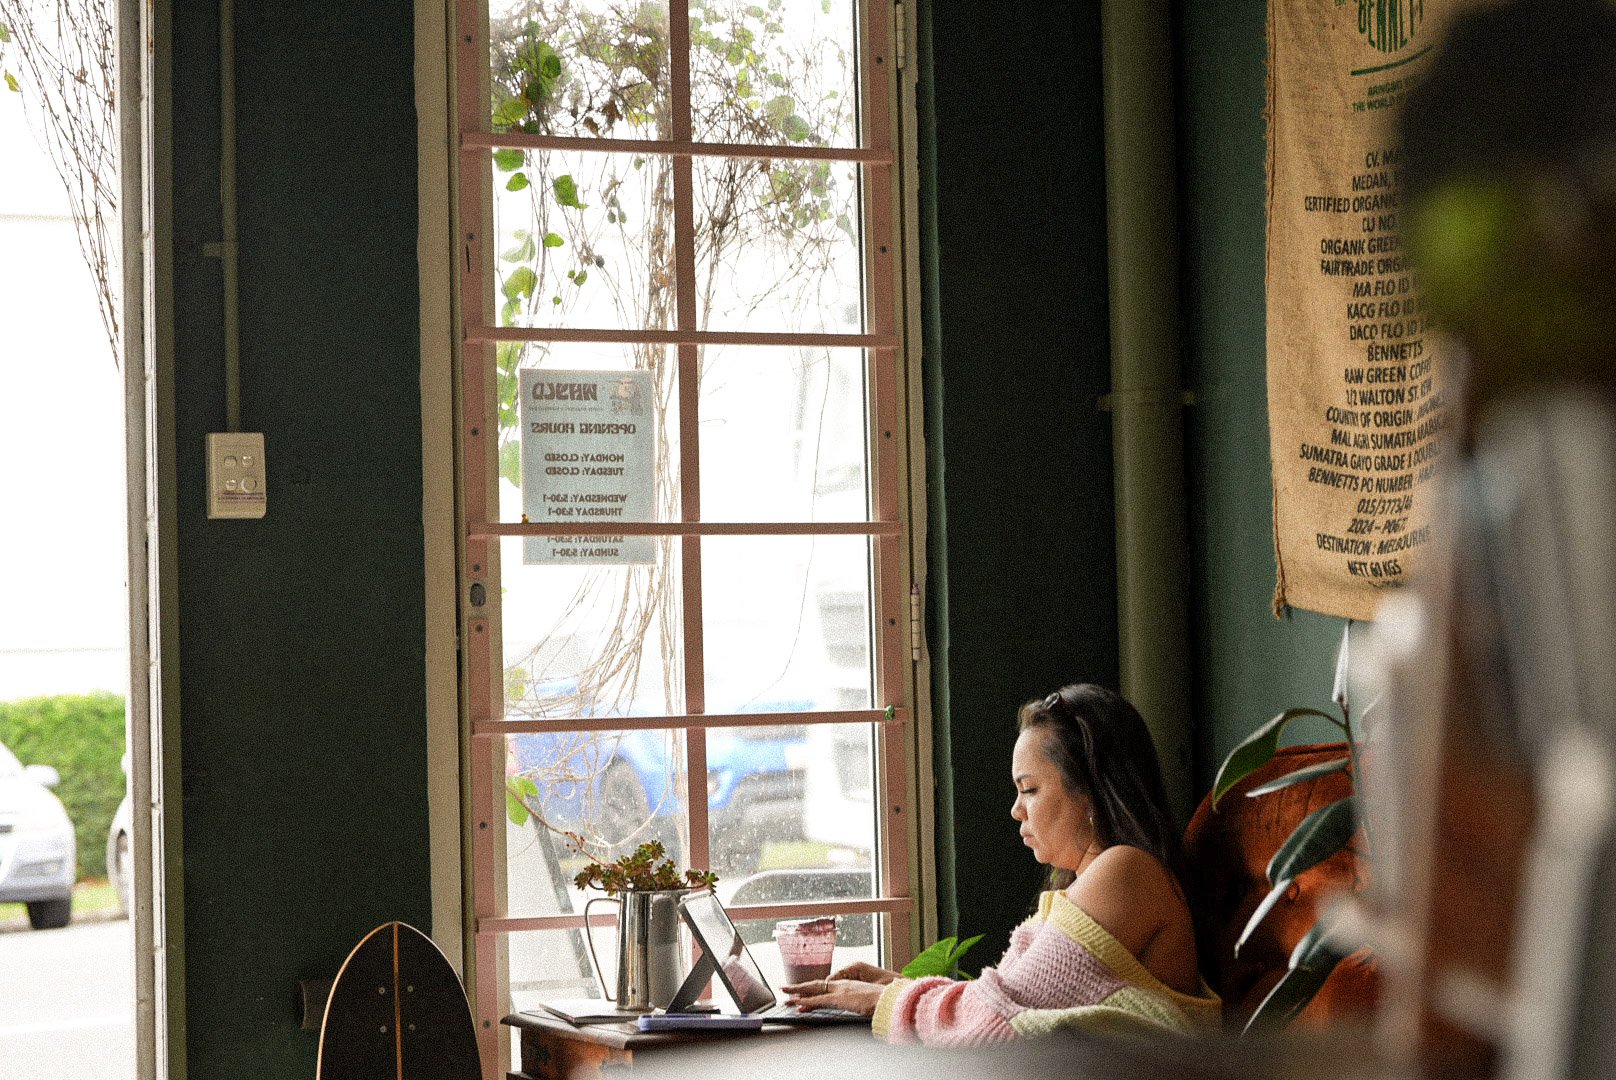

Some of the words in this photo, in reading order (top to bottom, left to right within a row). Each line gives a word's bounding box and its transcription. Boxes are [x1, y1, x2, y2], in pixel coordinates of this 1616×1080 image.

[1304, 195, 1350, 213] CERTIFIED
[1321, 259, 1374, 276] FAIRTRADE
[1374, 279, 1395, 296] FLO
[1347, 303, 1375, 319] KACG
[1378, 301, 1400, 318] FLO
[1381, 323, 1403, 339] FLO
[1368, 340, 1423, 362] BENNETTS
[1367, 366, 1406, 383] GREEN
[1360, 388, 1404, 406] WALTON
[1327, 406, 1358, 427] COUNTRY
[1360, 411, 1371, 428] OF
[1374, 409, 1413, 428] ORIGIN
[1331, 429, 1351, 447] MAL
[1371, 429, 1416, 450] SUMATRA
[1300, 443, 1348, 468] SUMATRA
[1351, 454, 1372, 472] GAYO
[1374, 454, 1405, 472] GRADE
[1308, 467, 1359, 492] BENNETTS
[1361, 478, 1374, 493] PO
[1376, 474, 1413, 493] NUMBER
[1347, 518, 1374, 534] 2024
[1347, 560, 1368, 577] NETT
[1383, 559, 1402, 577] KGS
